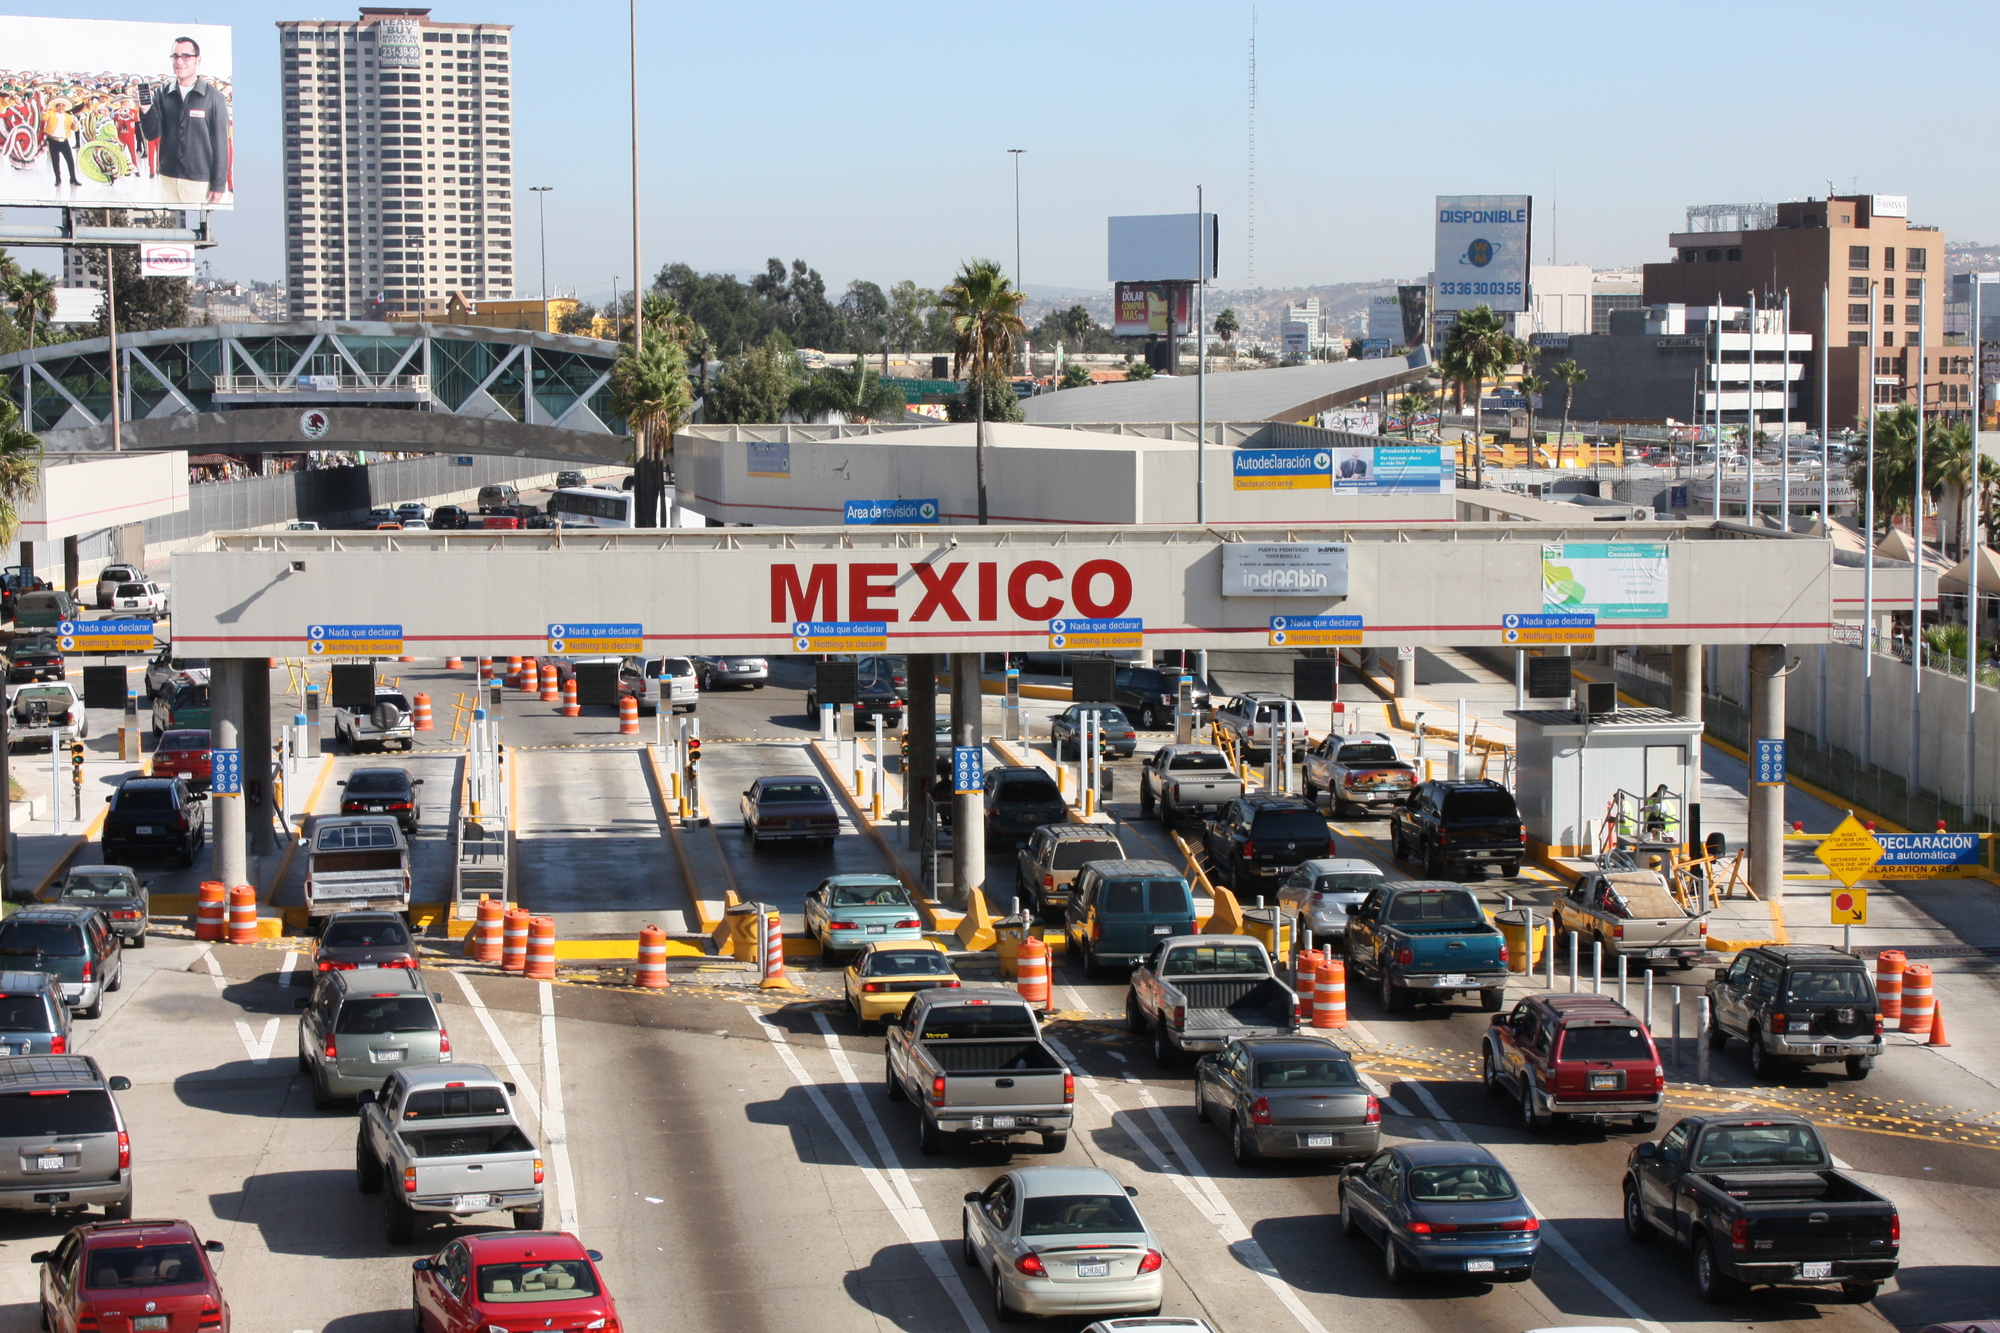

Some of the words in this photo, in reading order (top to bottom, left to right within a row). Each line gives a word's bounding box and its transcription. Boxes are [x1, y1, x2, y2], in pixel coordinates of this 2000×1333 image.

[383, 47, 419, 57] 231-39-99
[1440, 210, 1526, 223] DISPONIBLE
[1236, 454, 1311, 470] Autodeclaración
[847, 506, 868, 518] Area
[870, 506, 881, 518] de
[883, 505, 917, 517] revisión
[770, 559, 1132, 623] MEXICO
[368, 628, 399, 636] declarar
[1524, 632, 1552, 641] Nothing
[1071, 637, 1099, 646] Nothing
[1291, 634, 1320, 643] Nothing
[79, 639, 109, 648] Nothing
[329, 644, 358, 652] Nothing
[570, 642, 599, 651] Nothing
[814, 641, 843, 649] Nothing
[1875, 834, 1972, 849] DECLARACIÓN
[1897, 851, 1956, 859] automática
